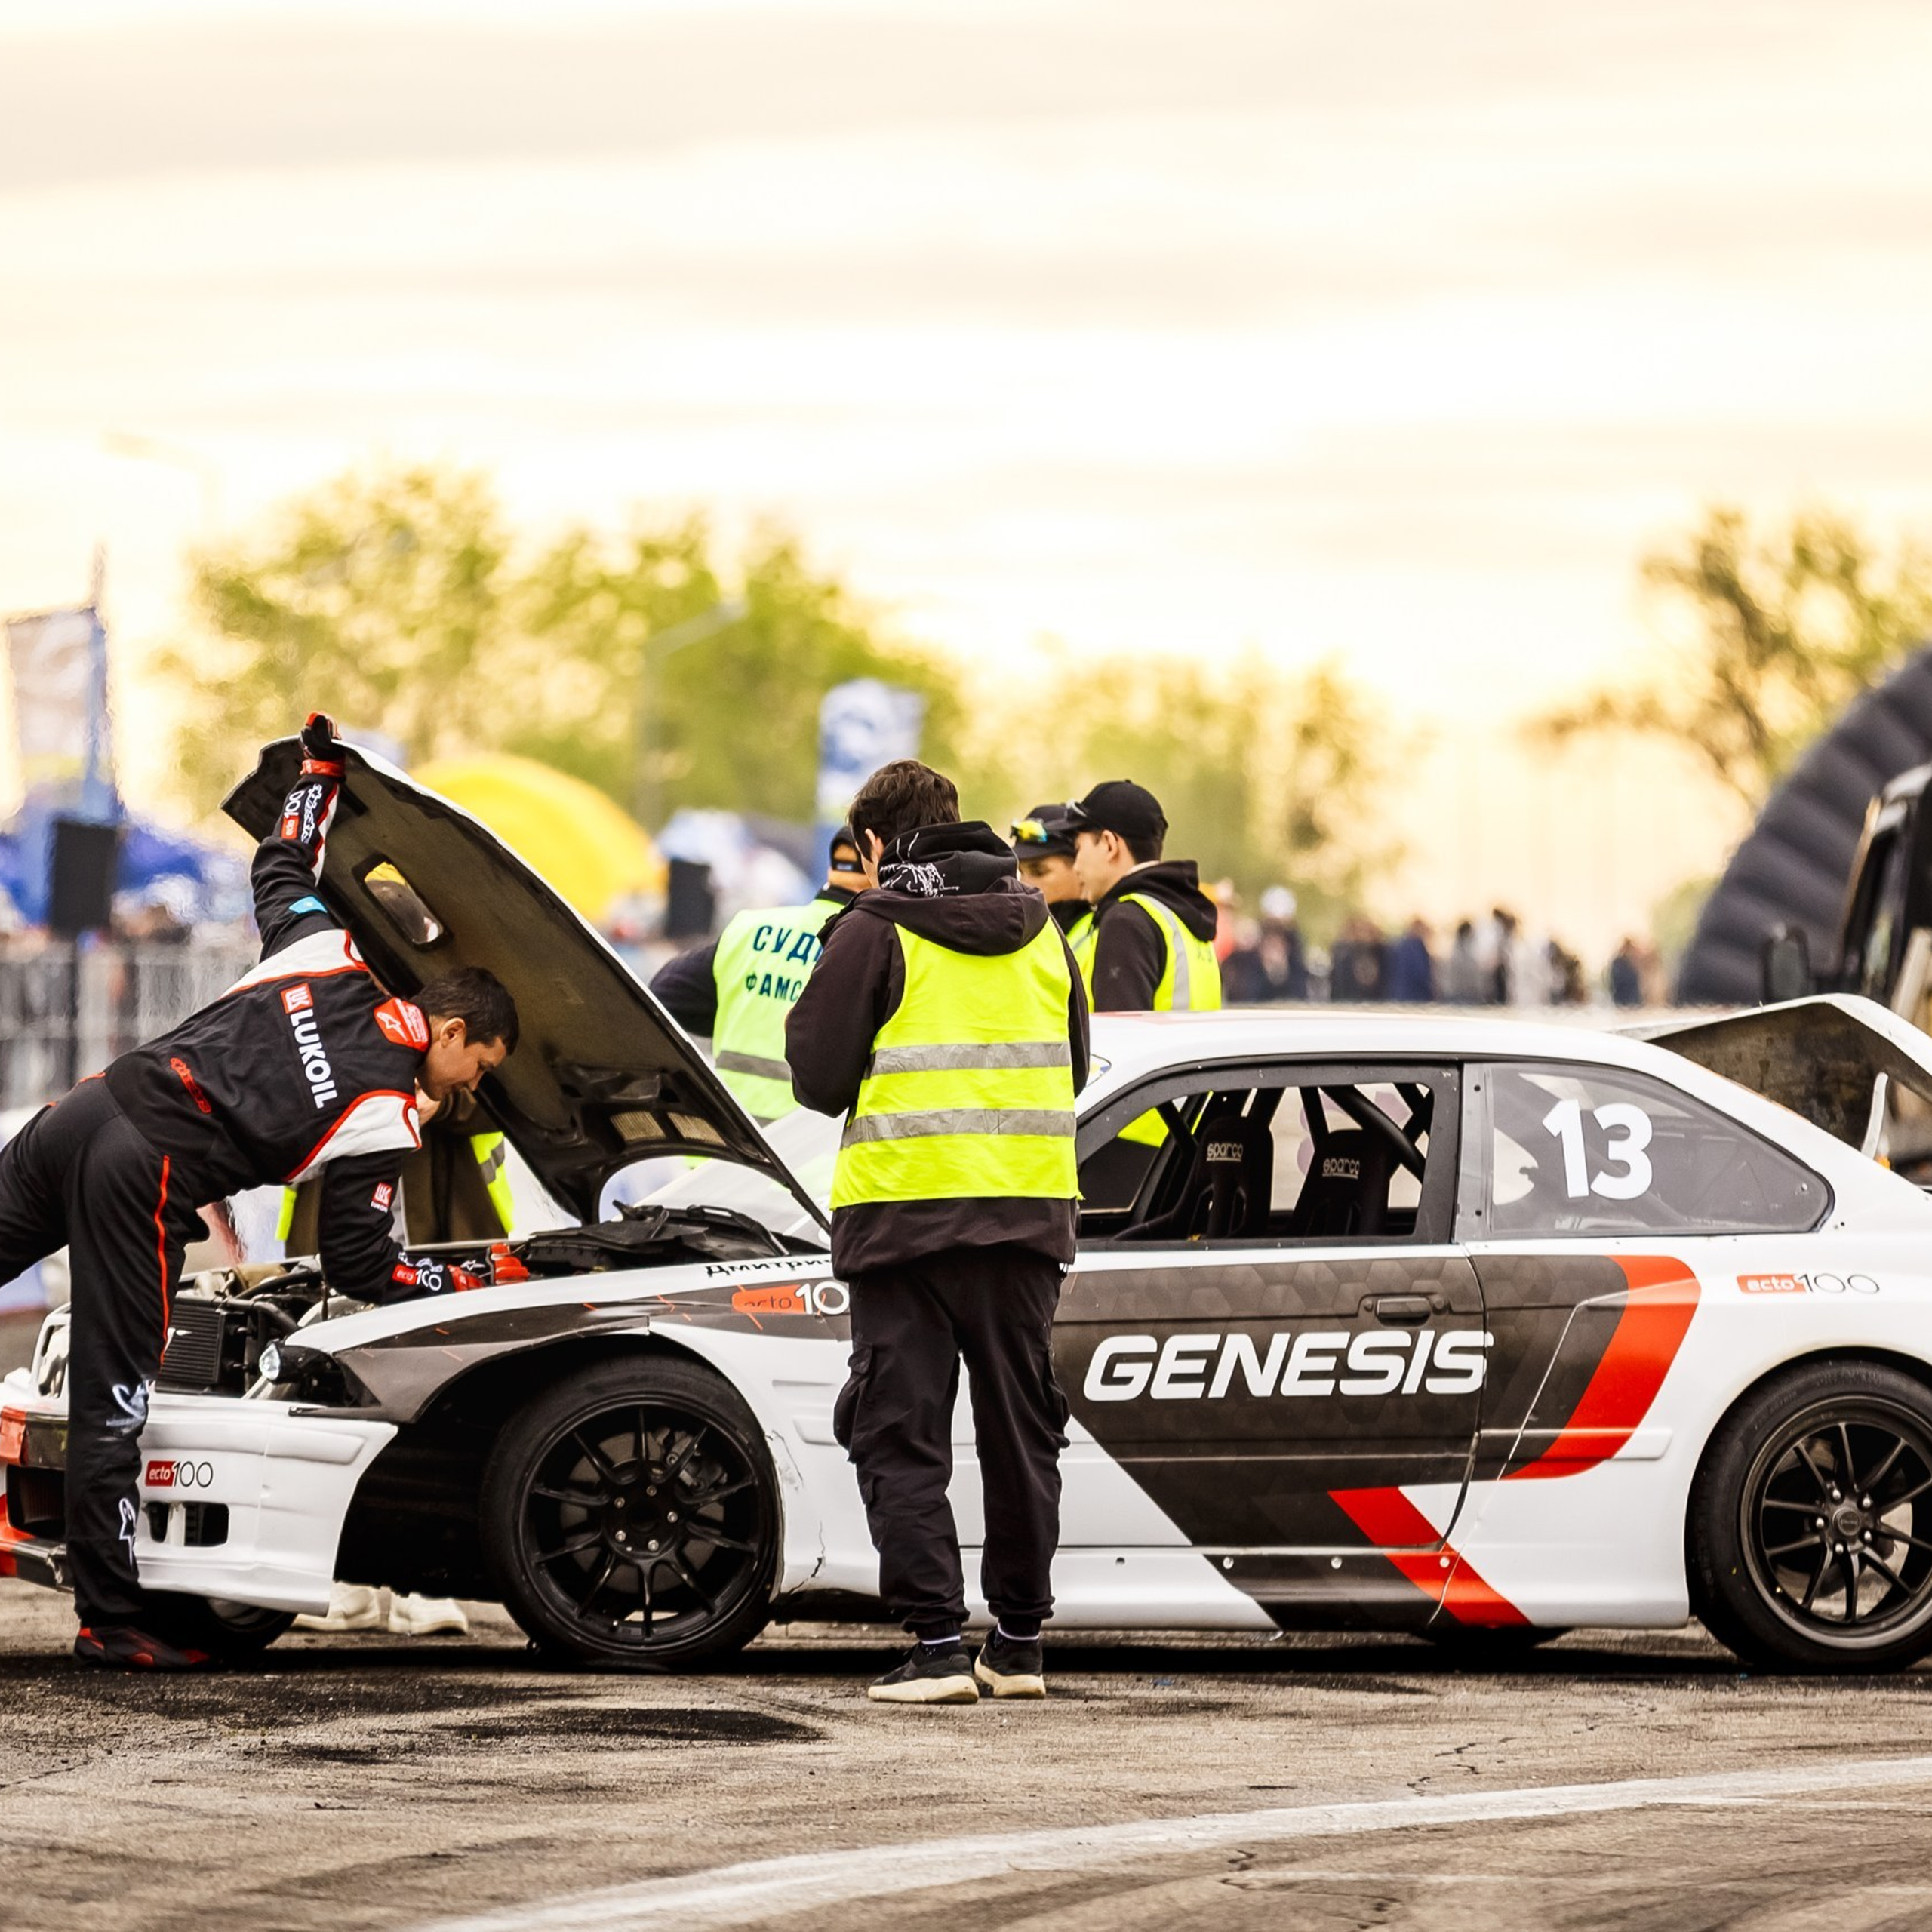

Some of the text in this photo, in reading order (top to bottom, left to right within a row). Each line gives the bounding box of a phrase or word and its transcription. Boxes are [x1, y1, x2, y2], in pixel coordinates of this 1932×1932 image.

[290, 1008, 338, 1109] LUKOIL
[1208, 1143, 1244, 1161] sparco
[1542, 1099, 1653, 1200] 13
[744, 1281, 850, 1315] ecto10
[1746, 1272, 1880, 1294] ecto100
[1084, 1331, 1494, 1401] GENESIS
[149, 1461, 214, 1488] ecto100
